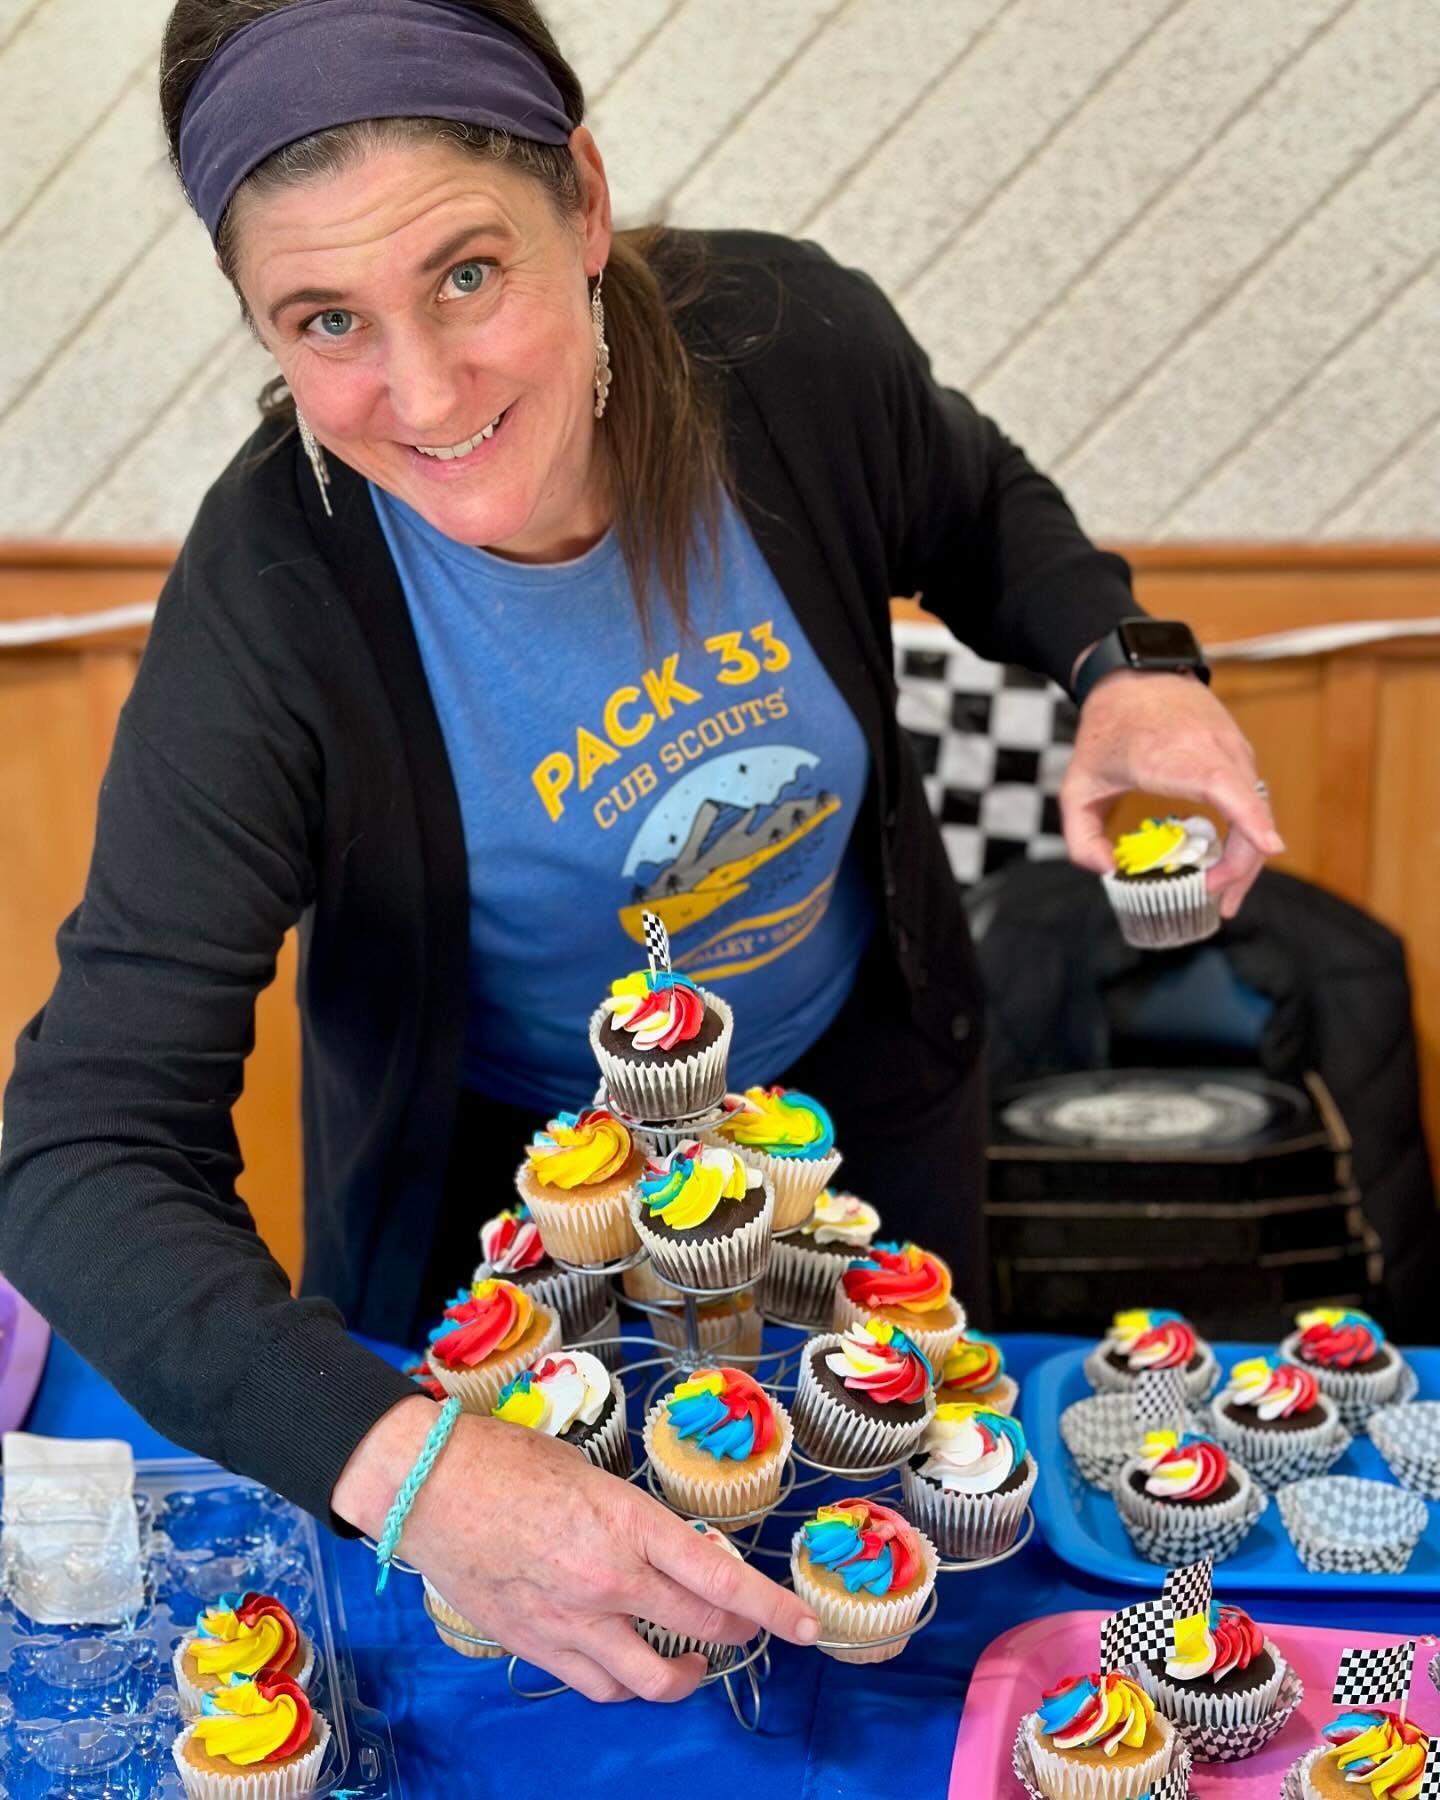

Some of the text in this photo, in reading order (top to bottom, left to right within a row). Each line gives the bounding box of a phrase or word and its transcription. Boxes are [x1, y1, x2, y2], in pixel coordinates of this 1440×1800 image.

[532, 621, 791, 823] PACK 33
[593, 691, 789, 829] CUB SCOUTS
